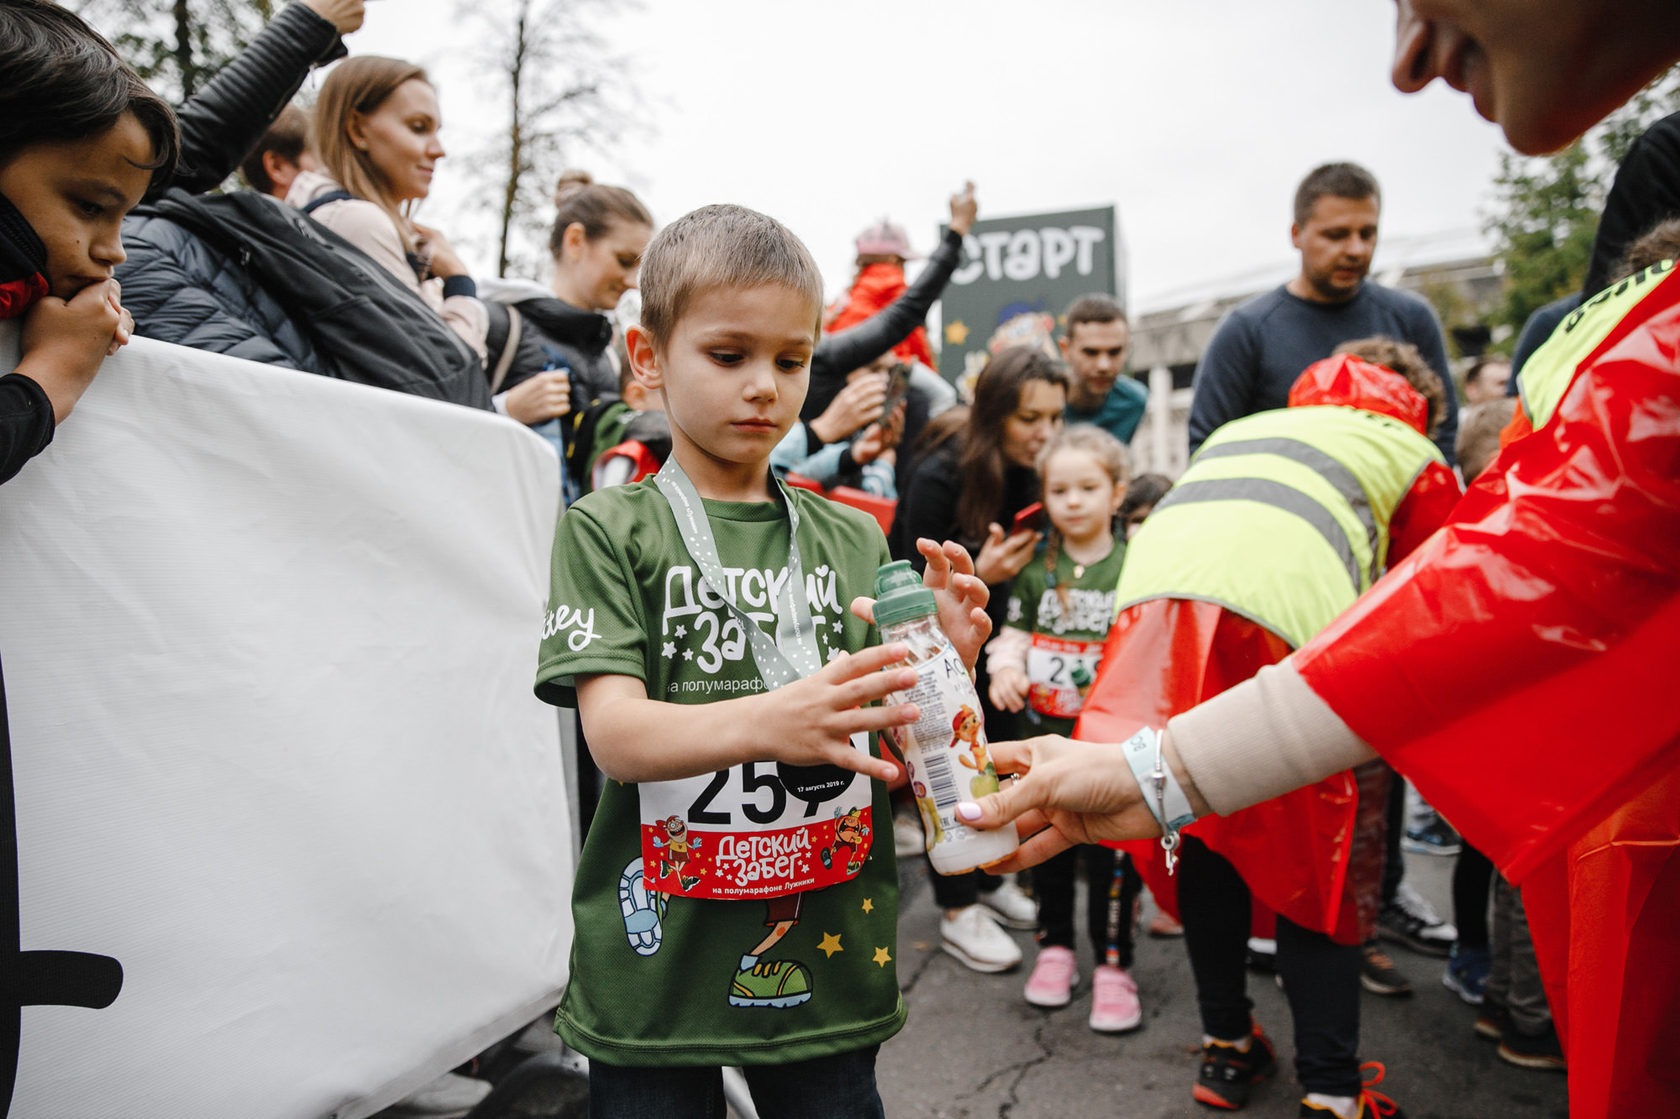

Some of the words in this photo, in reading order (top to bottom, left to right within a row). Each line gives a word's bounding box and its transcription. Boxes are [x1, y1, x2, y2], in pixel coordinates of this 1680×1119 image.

[826, 780, 839, 788] 2019
[716, 827, 812, 867] Детский
[724, 885, 783, 895] полумарафоне
[784, 878, 815, 890] Лужники
